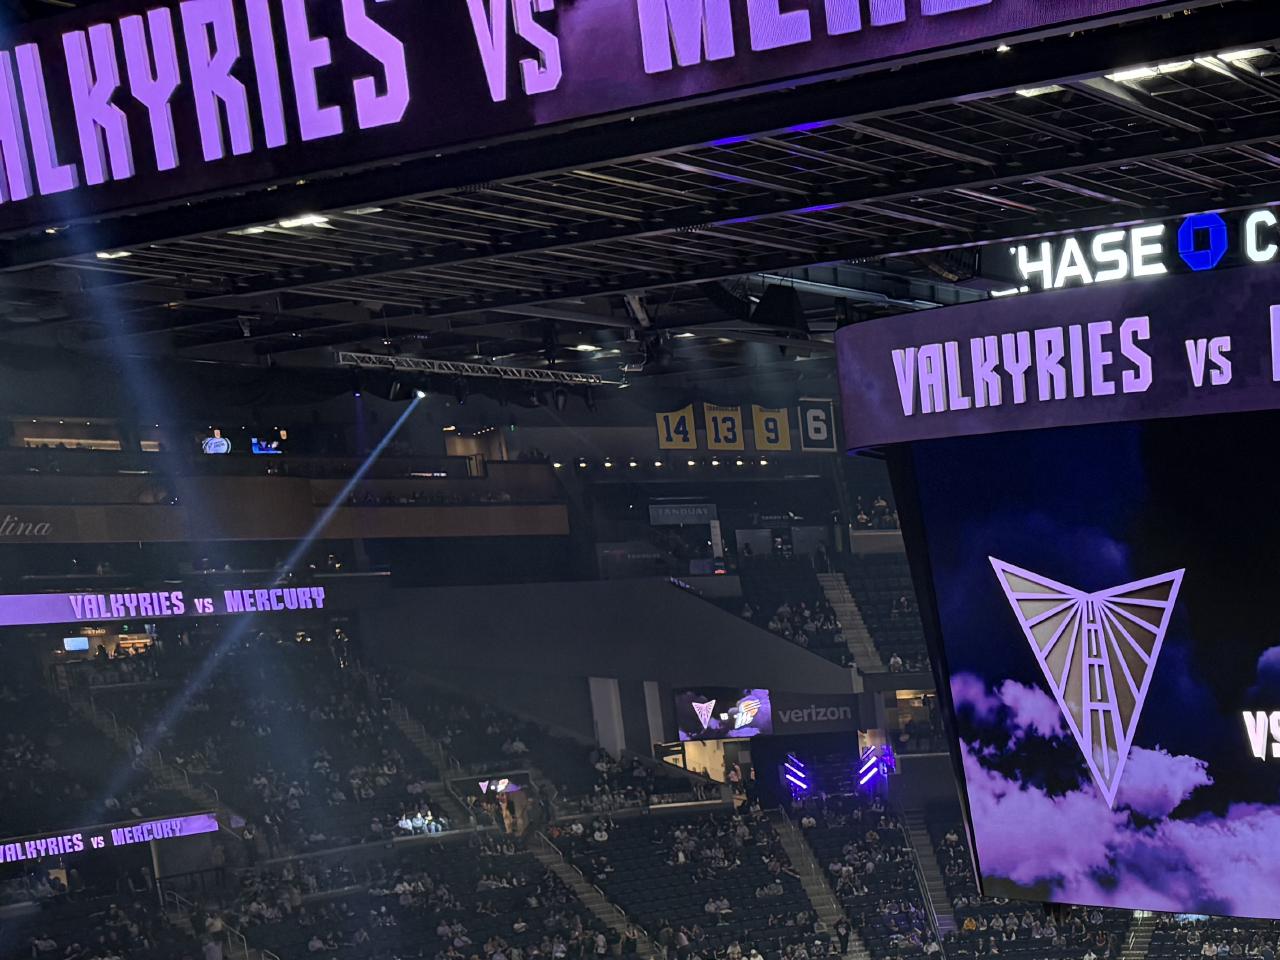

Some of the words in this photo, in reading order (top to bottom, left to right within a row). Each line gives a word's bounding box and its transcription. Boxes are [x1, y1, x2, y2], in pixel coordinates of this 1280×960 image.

[464, 0, 563, 102] VS
[990, 224, 1168, 297] HASE
[891, 315, 1152, 417] VALKYRIES
[1184, 335, 1232, 388] VS
[663, 415, 690, 443] 14
[711, 416, 738, 444] 13
[764, 417, 780, 444] 9
[806, 408, 828, 441] 6
[69, 591, 185, 619] VALKYRIES
[194, 598, 214, 614] VS
[223, 587, 325, 613] MERCURY
[777, 704, 850, 724] verizon
[90, 835, 105, 849] VS
[111, 819, 182, 847] MERCURY
